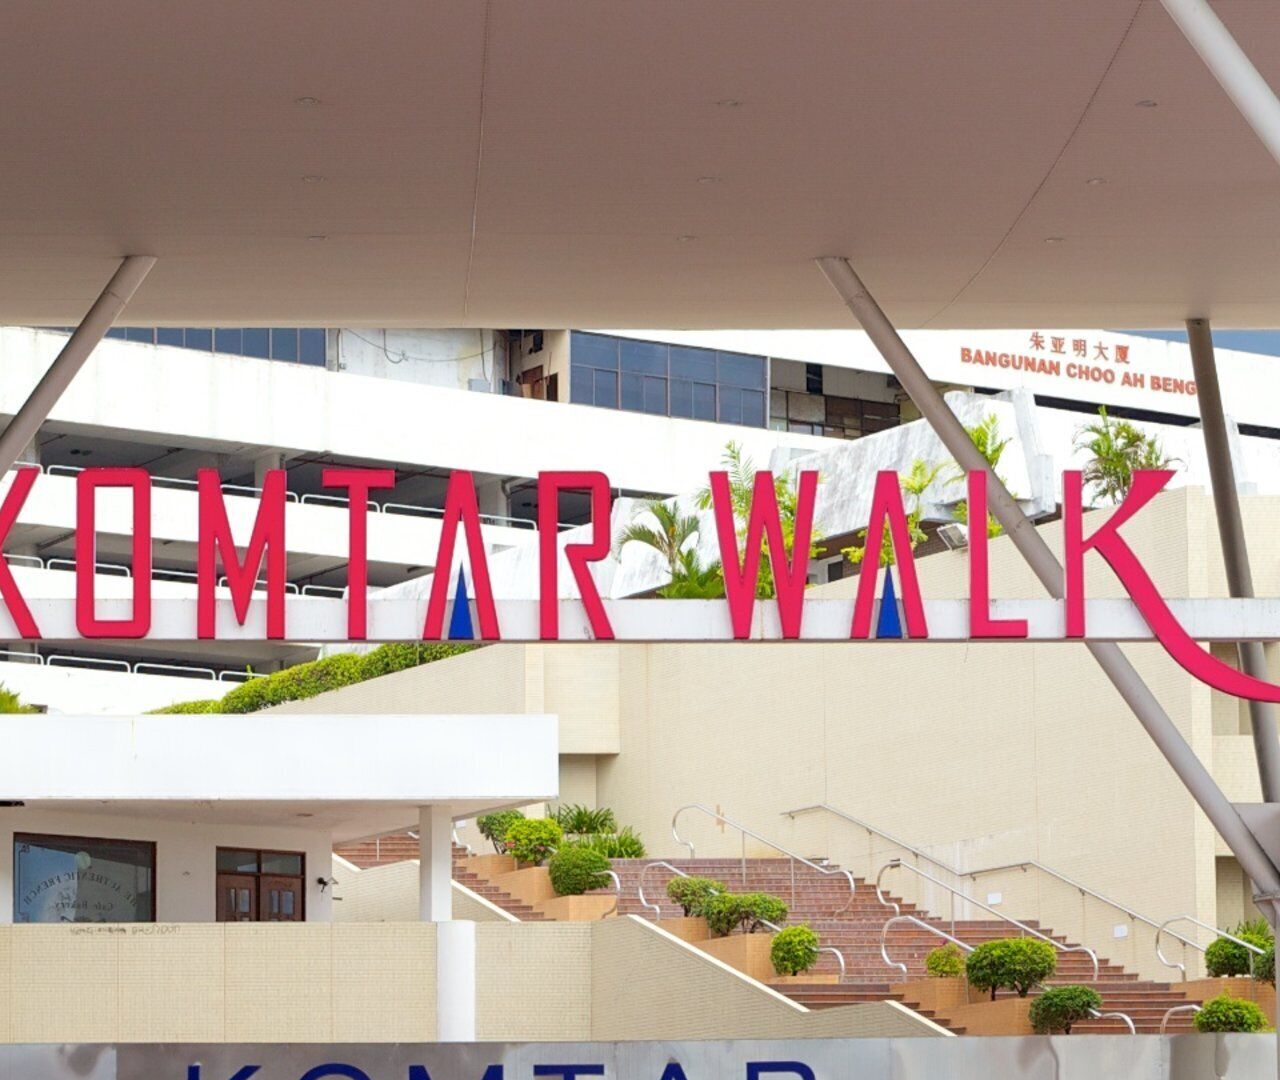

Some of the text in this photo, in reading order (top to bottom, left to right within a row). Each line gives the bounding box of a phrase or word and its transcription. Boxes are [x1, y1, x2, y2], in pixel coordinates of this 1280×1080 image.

[1029, 331, 1130, 365] 朱亚明大厦
[960, 347, 1198, 396] BANGUNAN CHOO AH BENG
